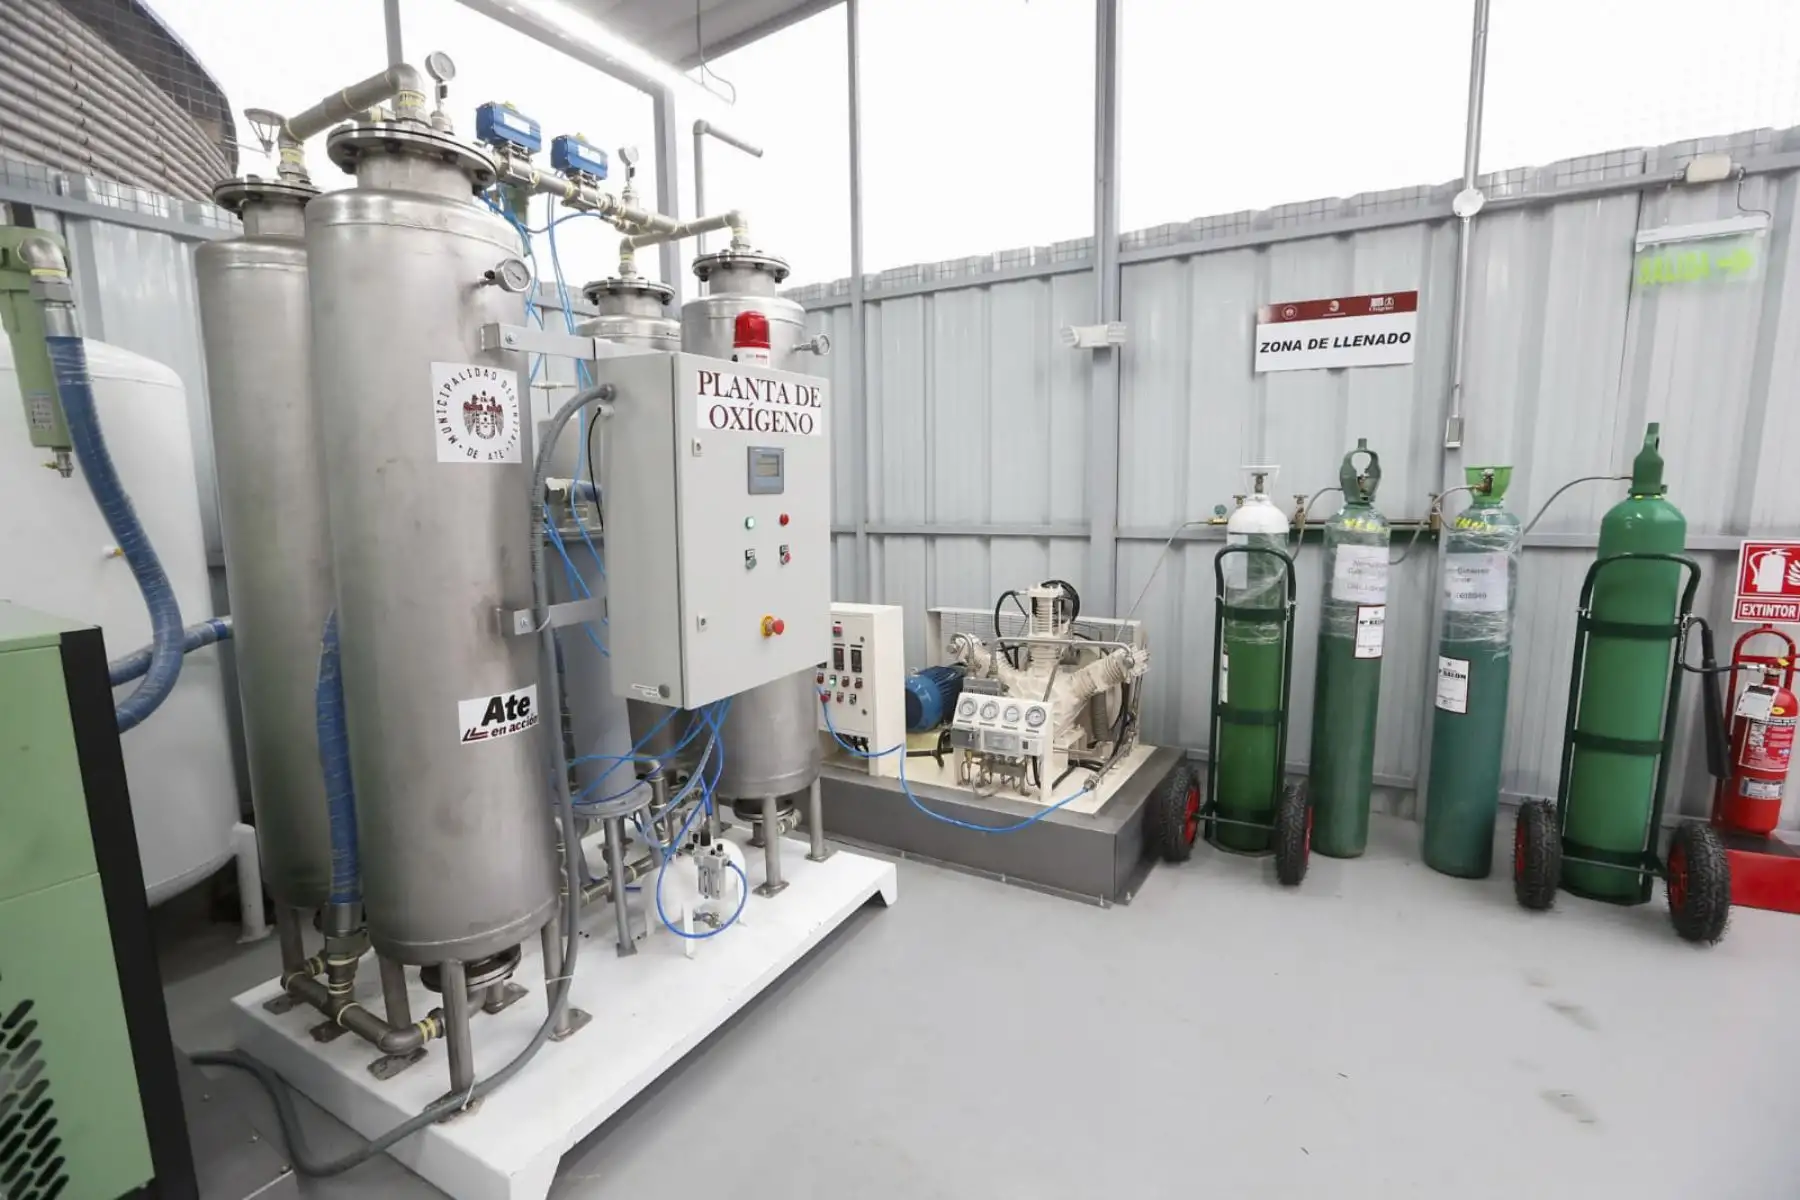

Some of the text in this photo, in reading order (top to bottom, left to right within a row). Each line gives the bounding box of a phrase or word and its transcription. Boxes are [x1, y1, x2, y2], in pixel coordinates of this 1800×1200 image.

[1260, 331, 1412, 354] ZONA DE LLENADO
[697, 369, 822, 408] PLANTA DE
[436, 367, 497, 445] MUNICIPALIDAD
[709, 401, 814, 435] OXÍGENO
[466, 447, 505, 460] DE ATE
[1741, 603, 1797, 618] EXTINTOR
[481, 693, 531, 727] Ate
[491, 726, 507, 737] en
